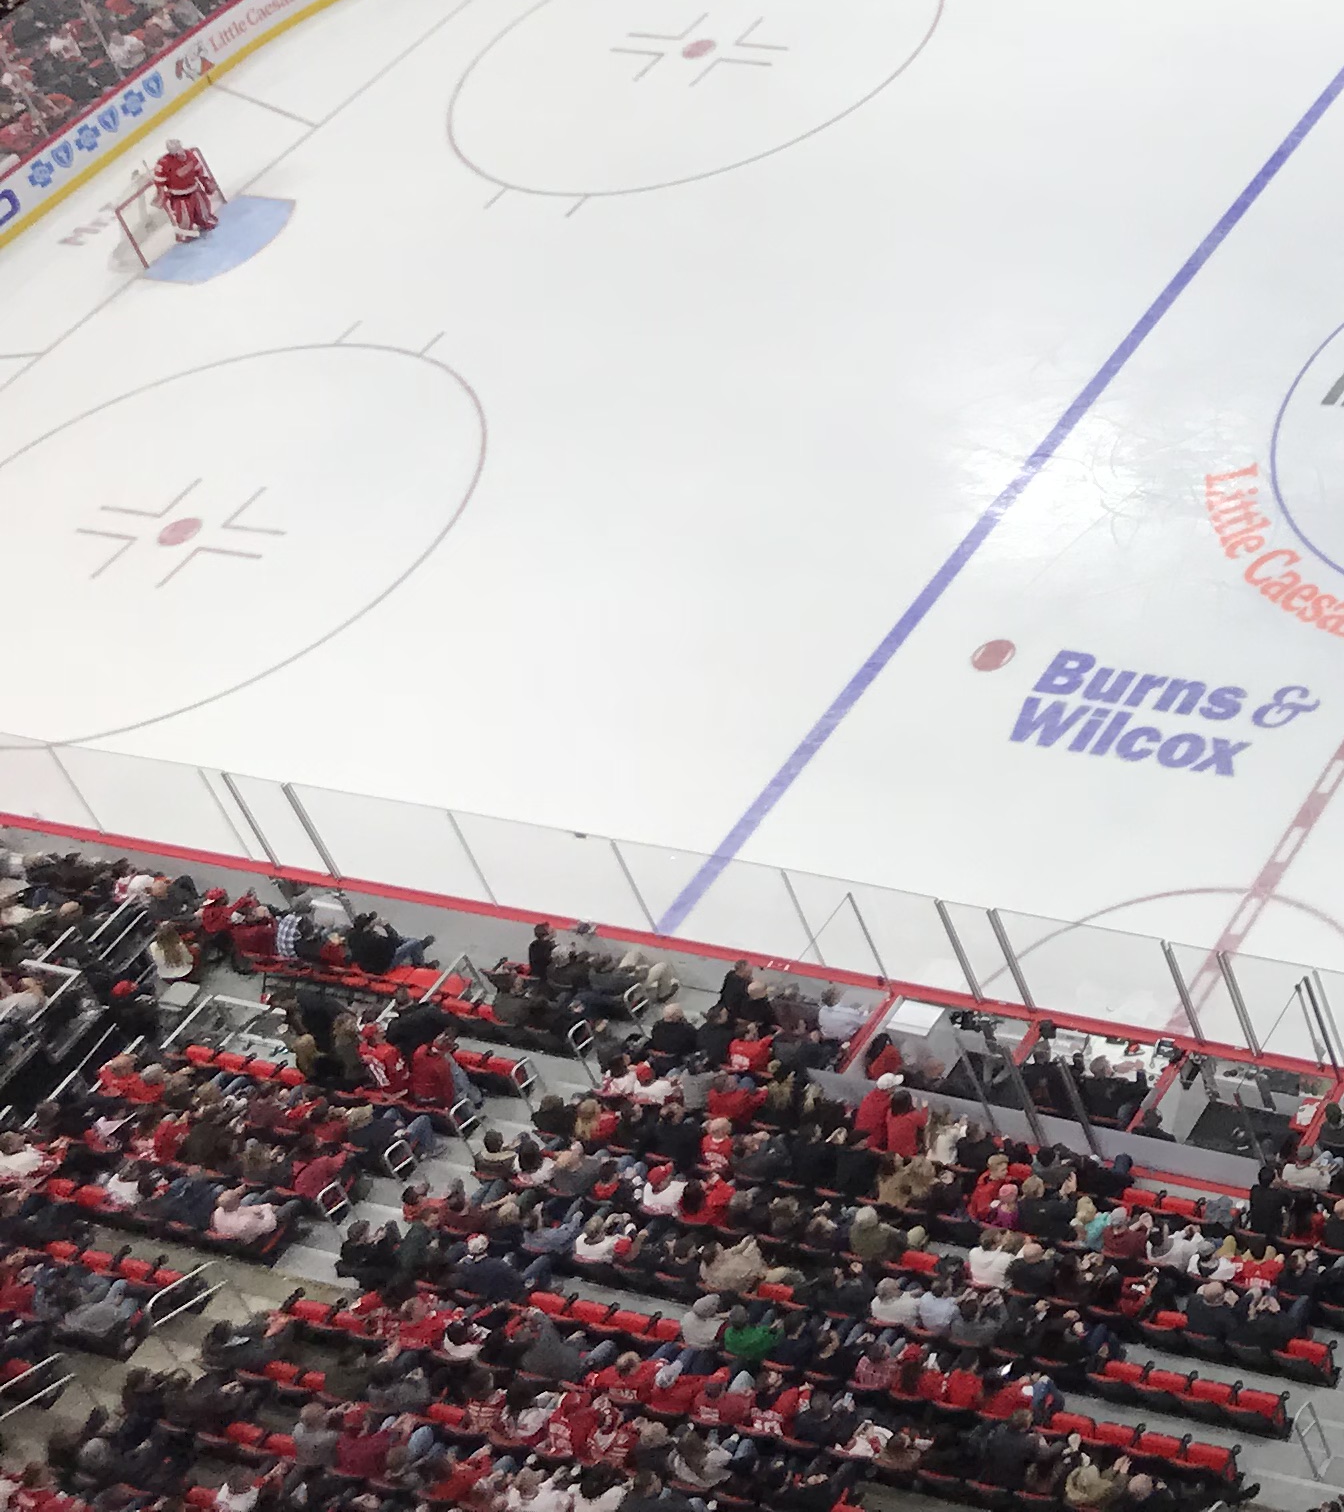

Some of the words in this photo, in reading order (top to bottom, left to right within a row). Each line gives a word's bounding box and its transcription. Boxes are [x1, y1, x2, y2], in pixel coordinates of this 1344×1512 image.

[1205, 463, 1264, 559] Little
[1033, 649, 1249, 722] Burns
[1251, 684, 1321, 729] &
[1008, 696, 1255, 778] Wilcox
